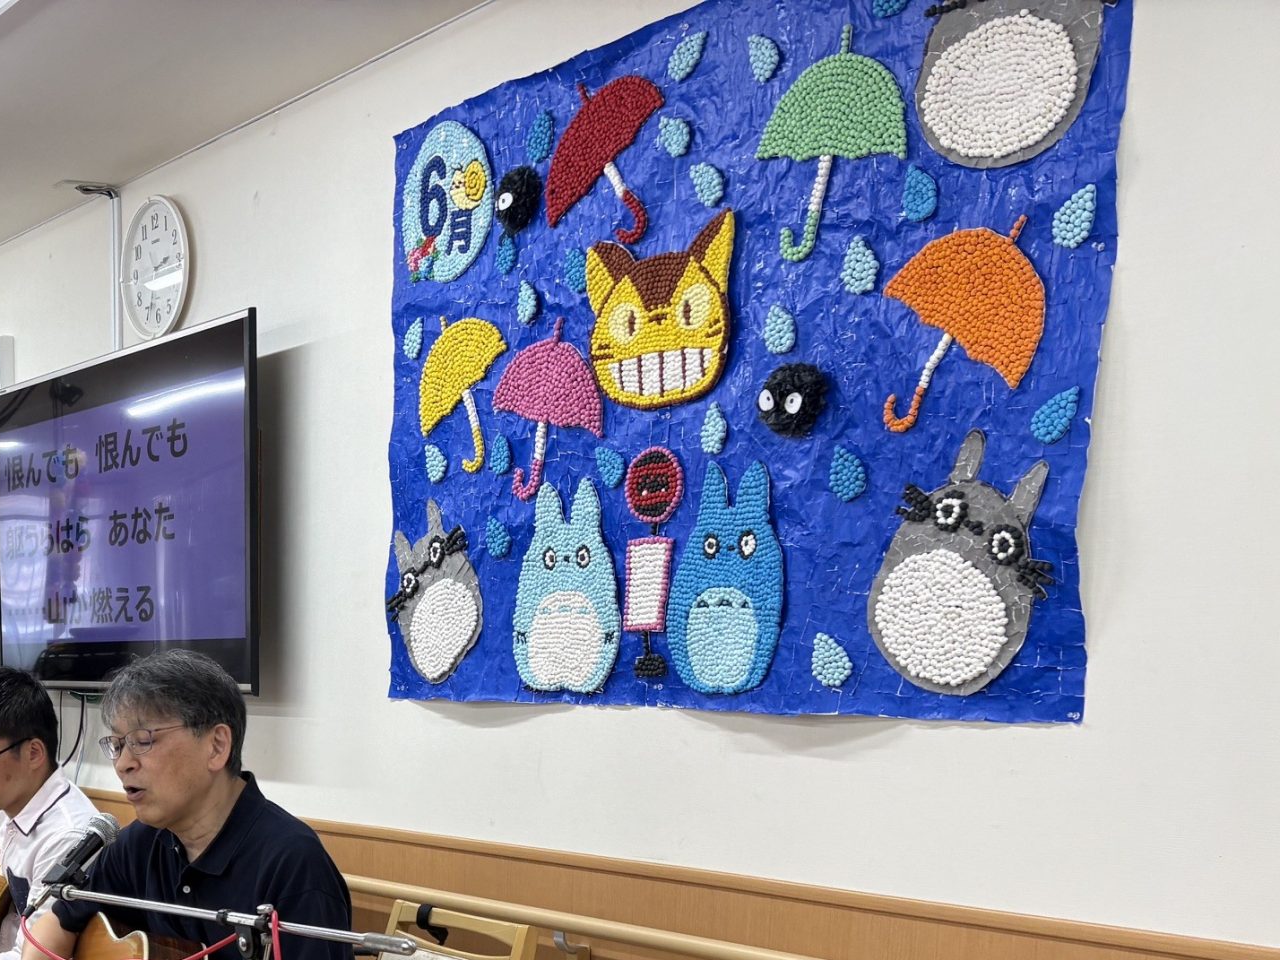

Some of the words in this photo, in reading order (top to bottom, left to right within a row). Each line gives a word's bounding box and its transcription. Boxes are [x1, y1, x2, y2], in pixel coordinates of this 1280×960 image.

[419, 155, 473, 256] 6月
[151, 212, 159, 231] 12
[163, 215, 168, 231] 1
[141, 224, 148, 242] 11
[171, 229, 178, 246] 2
[134, 244, 142, 262] 10
[132, 269, 139, 285] 9
[136, 291, 143, 307] 8
[166, 298, 172, 315] 5
[144, 306, 150, 323] 7
[155, 308, 161, 324] 6
[4, 443, 80, 493] 恨んでも
[95, 417, 188, 474] 恨んでも
[108, 502, 176, 547] あなた
